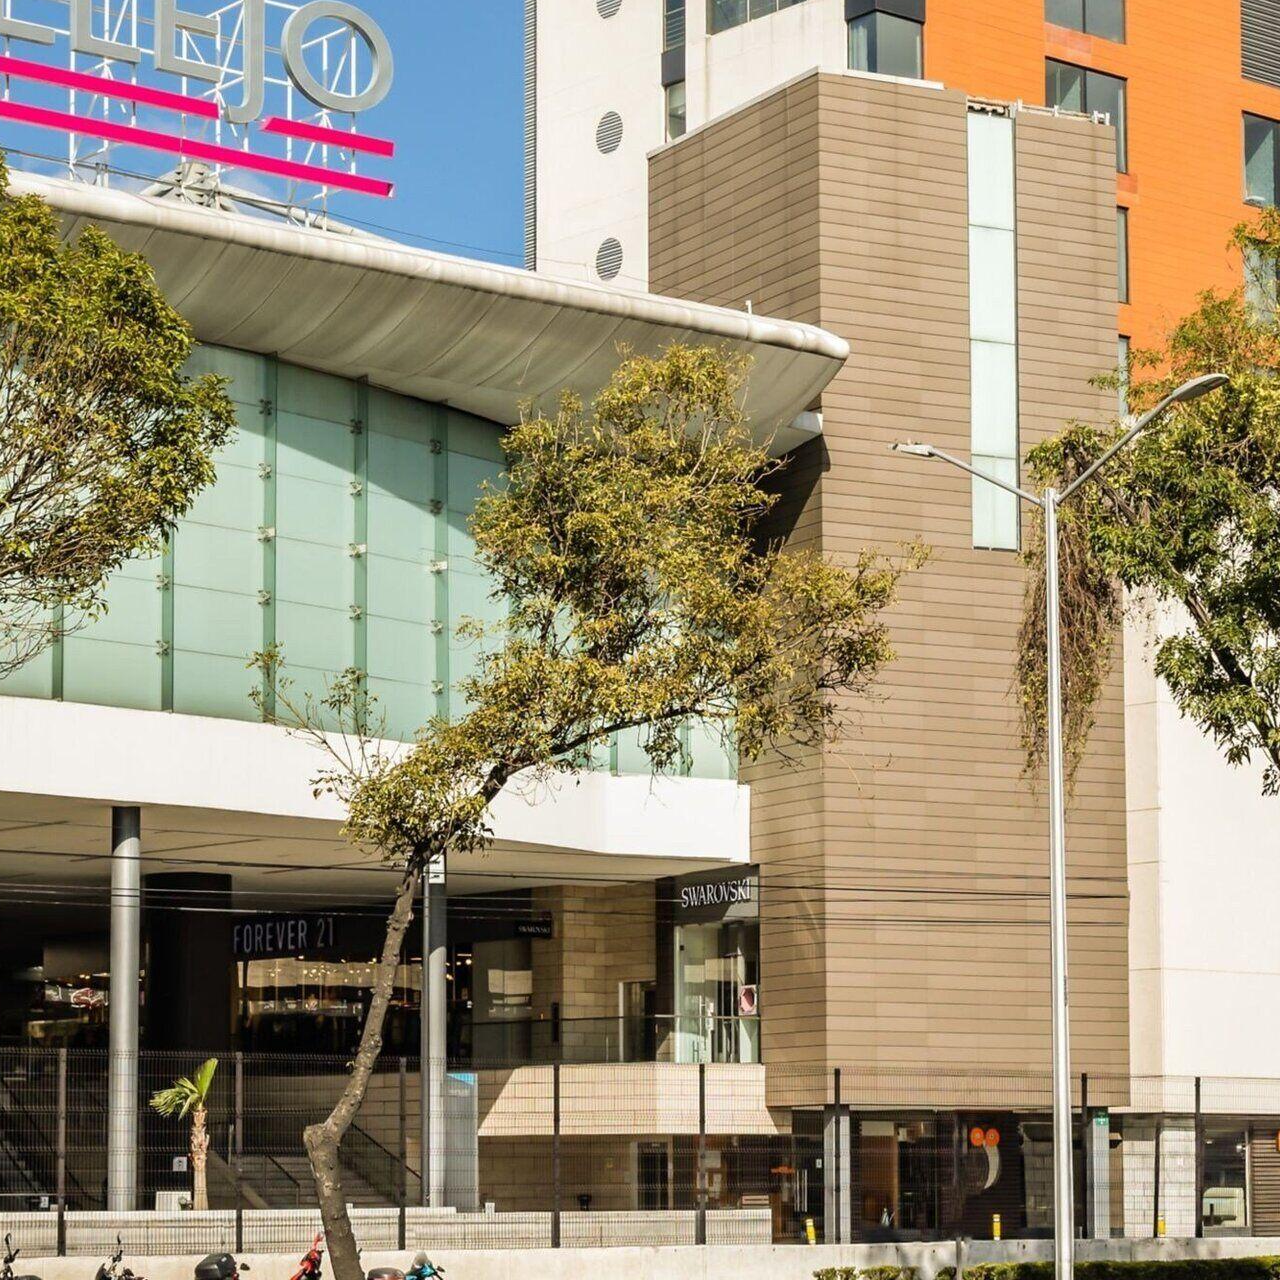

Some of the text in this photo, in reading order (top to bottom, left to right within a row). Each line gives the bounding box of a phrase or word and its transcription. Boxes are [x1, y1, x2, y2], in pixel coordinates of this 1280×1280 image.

[681, 878, 752, 908] SWAROVSKI
[233, 917, 334, 954] FOREVER 21
